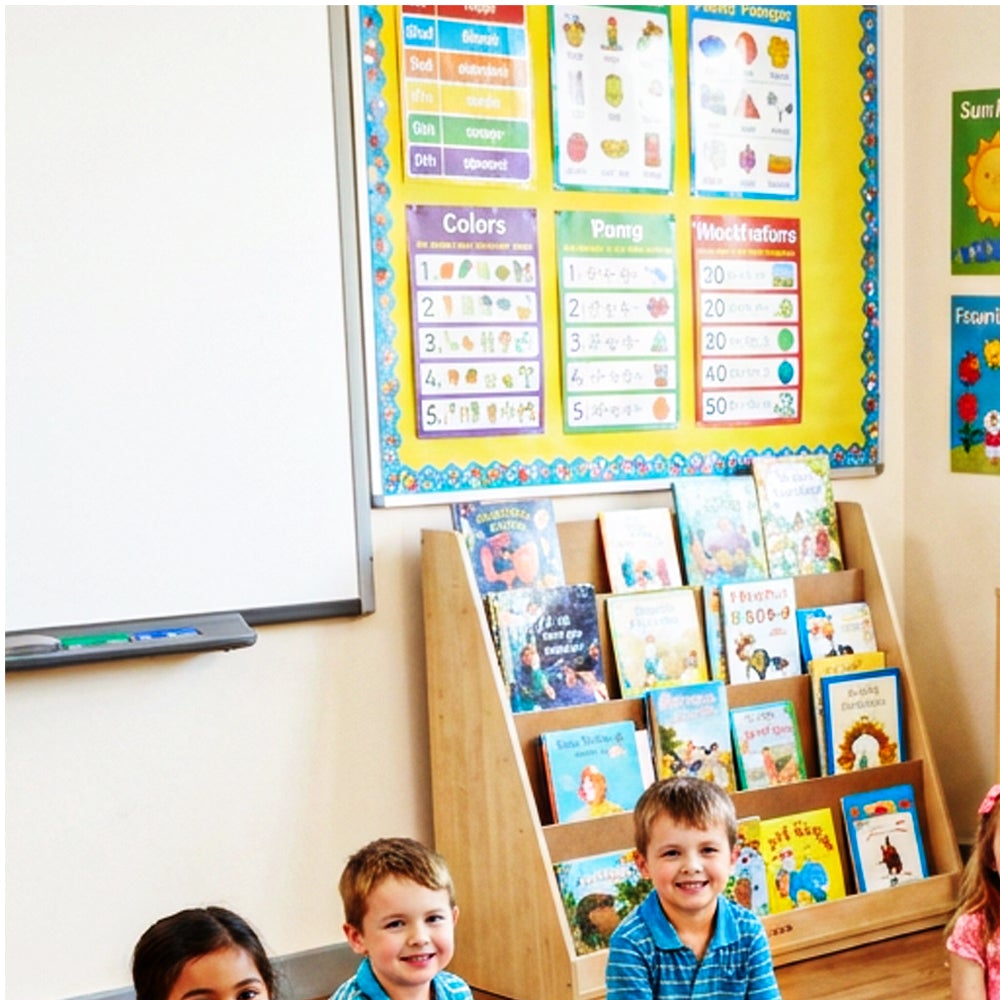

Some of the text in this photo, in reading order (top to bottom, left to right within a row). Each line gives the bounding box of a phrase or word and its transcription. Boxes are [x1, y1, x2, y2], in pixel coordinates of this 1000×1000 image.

[443, 212, 507, 235] Colors
[705, 364, 727, 382] 40
[706, 397, 727, 415] 50
